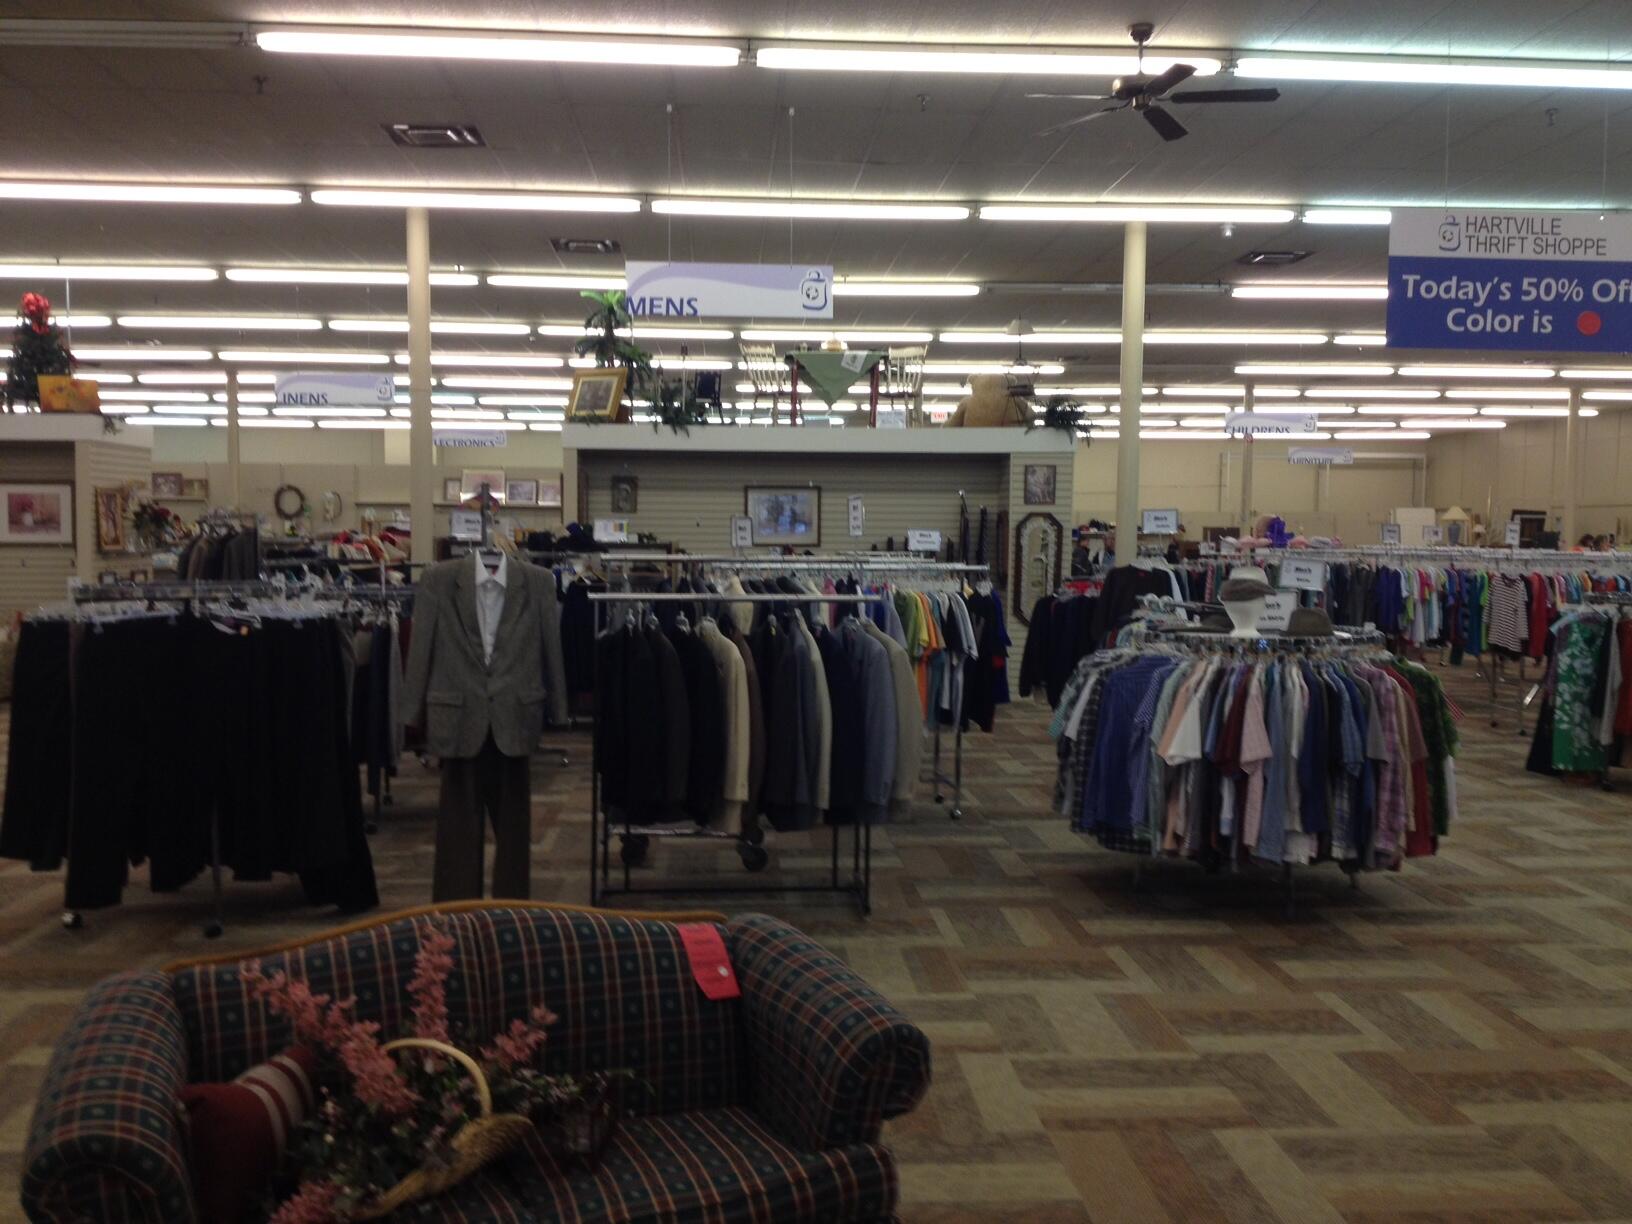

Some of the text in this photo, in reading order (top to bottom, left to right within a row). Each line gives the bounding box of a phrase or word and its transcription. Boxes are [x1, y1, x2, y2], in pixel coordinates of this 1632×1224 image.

[1465, 215, 1562, 236] HARTVILLE
[1465, 235, 1607, 257] THRIFT SHOPPE
[1401, 274, 1632, 307] Today's 50% Of
[624, 296, 698, 317] MENS
[1446, 307, 1553, 334] Color is
